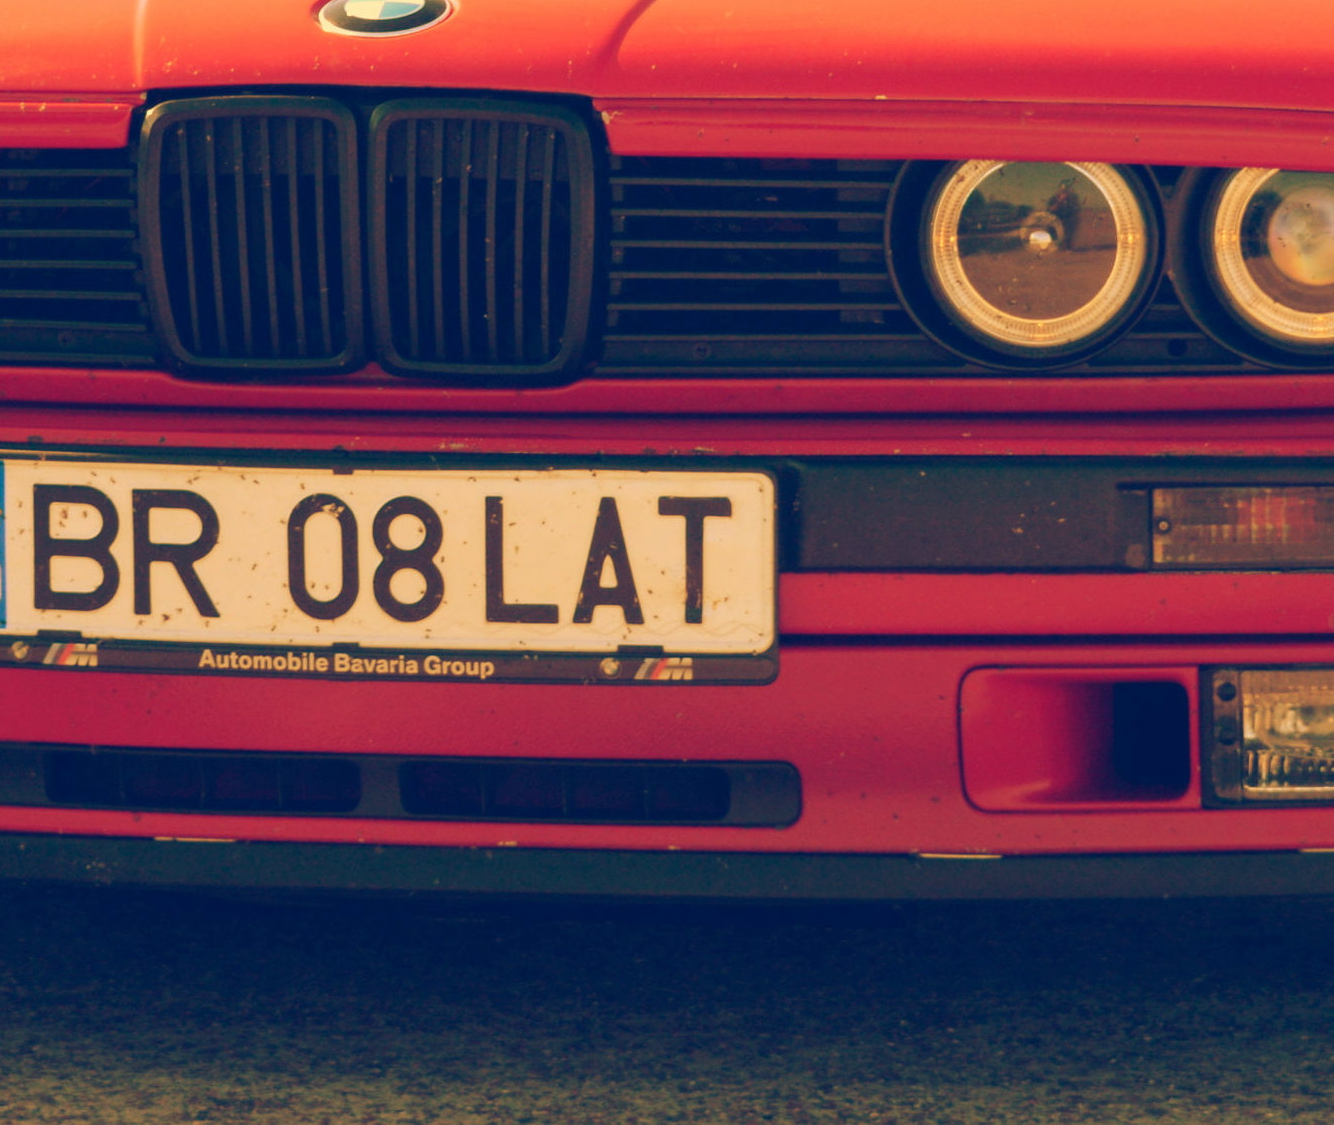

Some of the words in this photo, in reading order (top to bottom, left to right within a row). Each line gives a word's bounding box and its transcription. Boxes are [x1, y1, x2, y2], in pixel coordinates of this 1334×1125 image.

[32, 483, 220, 617] BR
[287, 493, 445, 622] 08
[484, 495, 733, 625] LAT
[198, 648, 329, 672] Automobile
[333, 652, 419, 674] Bavaria
[423, 655, 495, 679] Group
